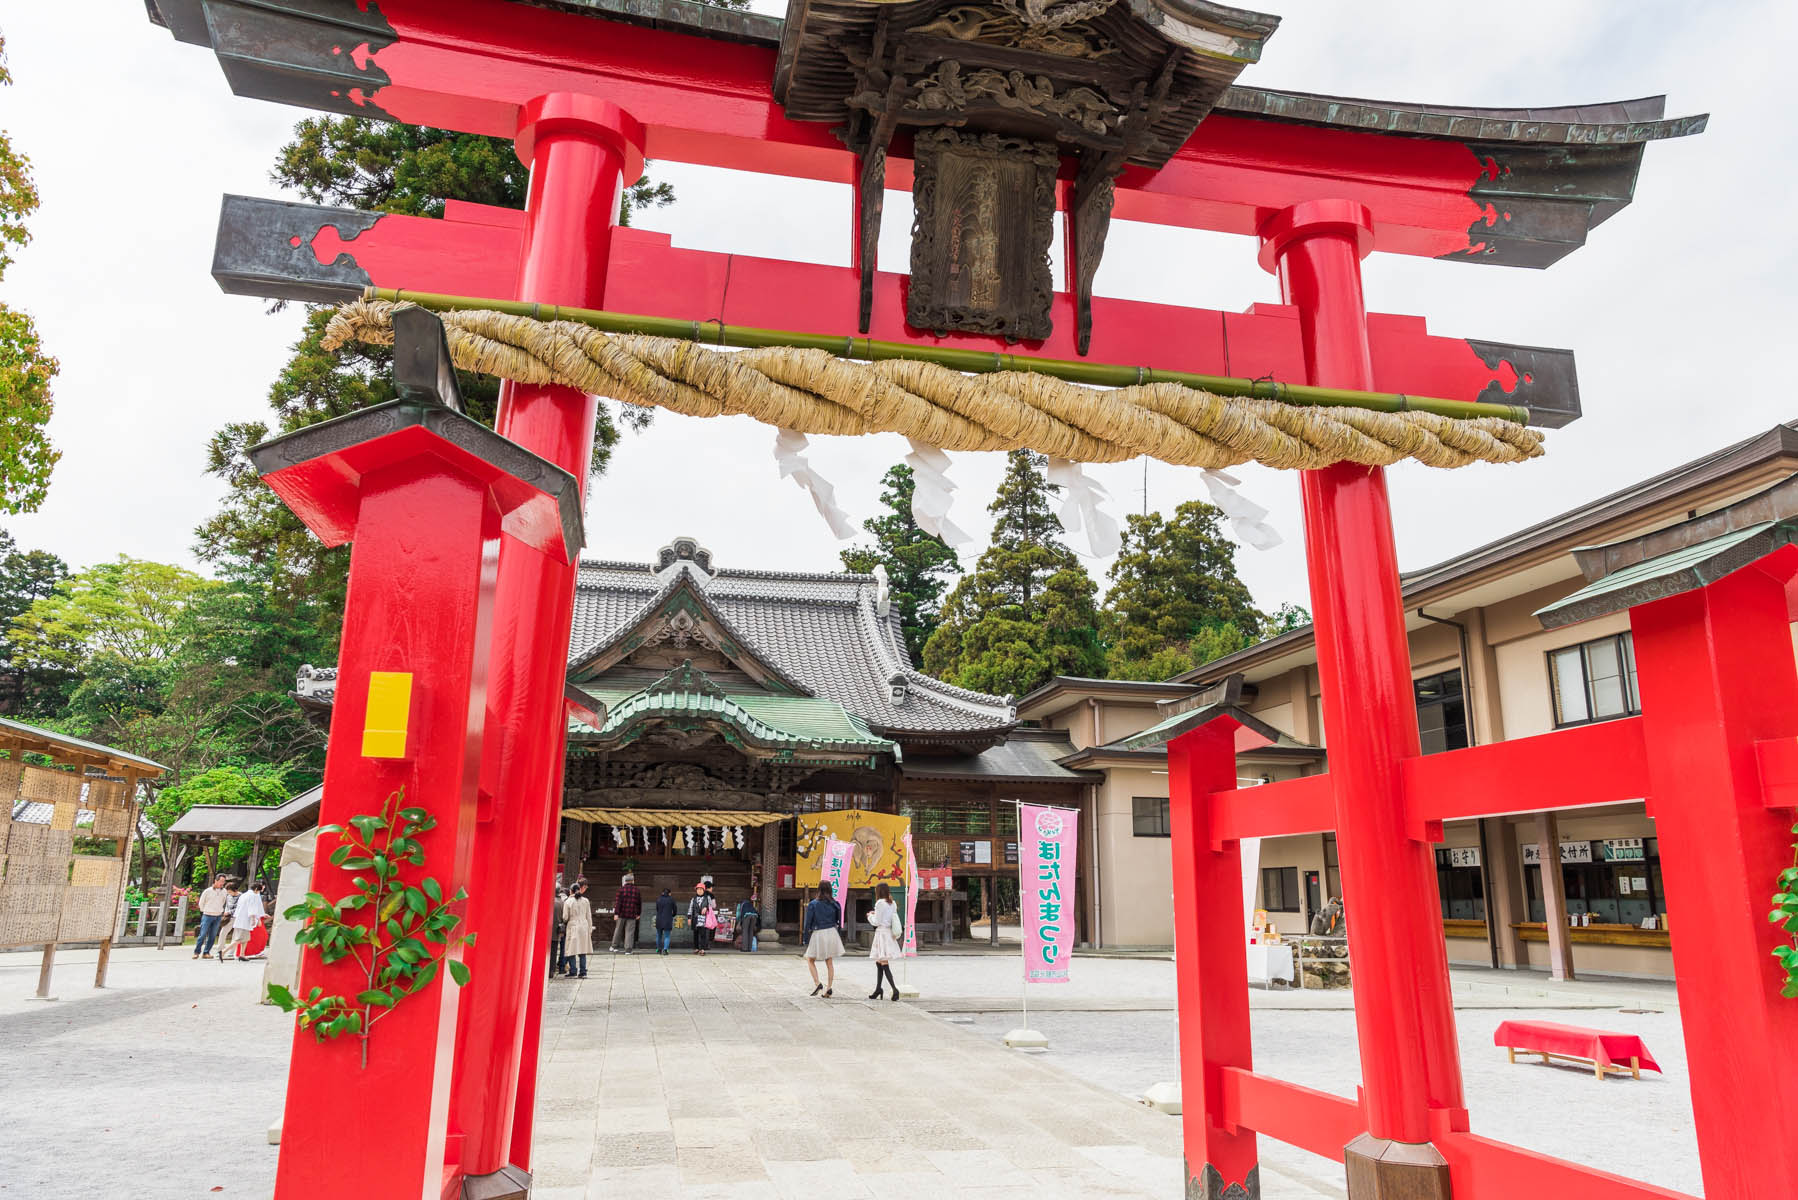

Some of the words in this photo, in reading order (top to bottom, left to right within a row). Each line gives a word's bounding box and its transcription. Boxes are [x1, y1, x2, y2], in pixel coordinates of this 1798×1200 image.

[1452, 849, 1476, 865] お守り
[1525, 845, 1589, 860] 御受付所
[1038, 841, 1061, 963] ぼたんまつり
